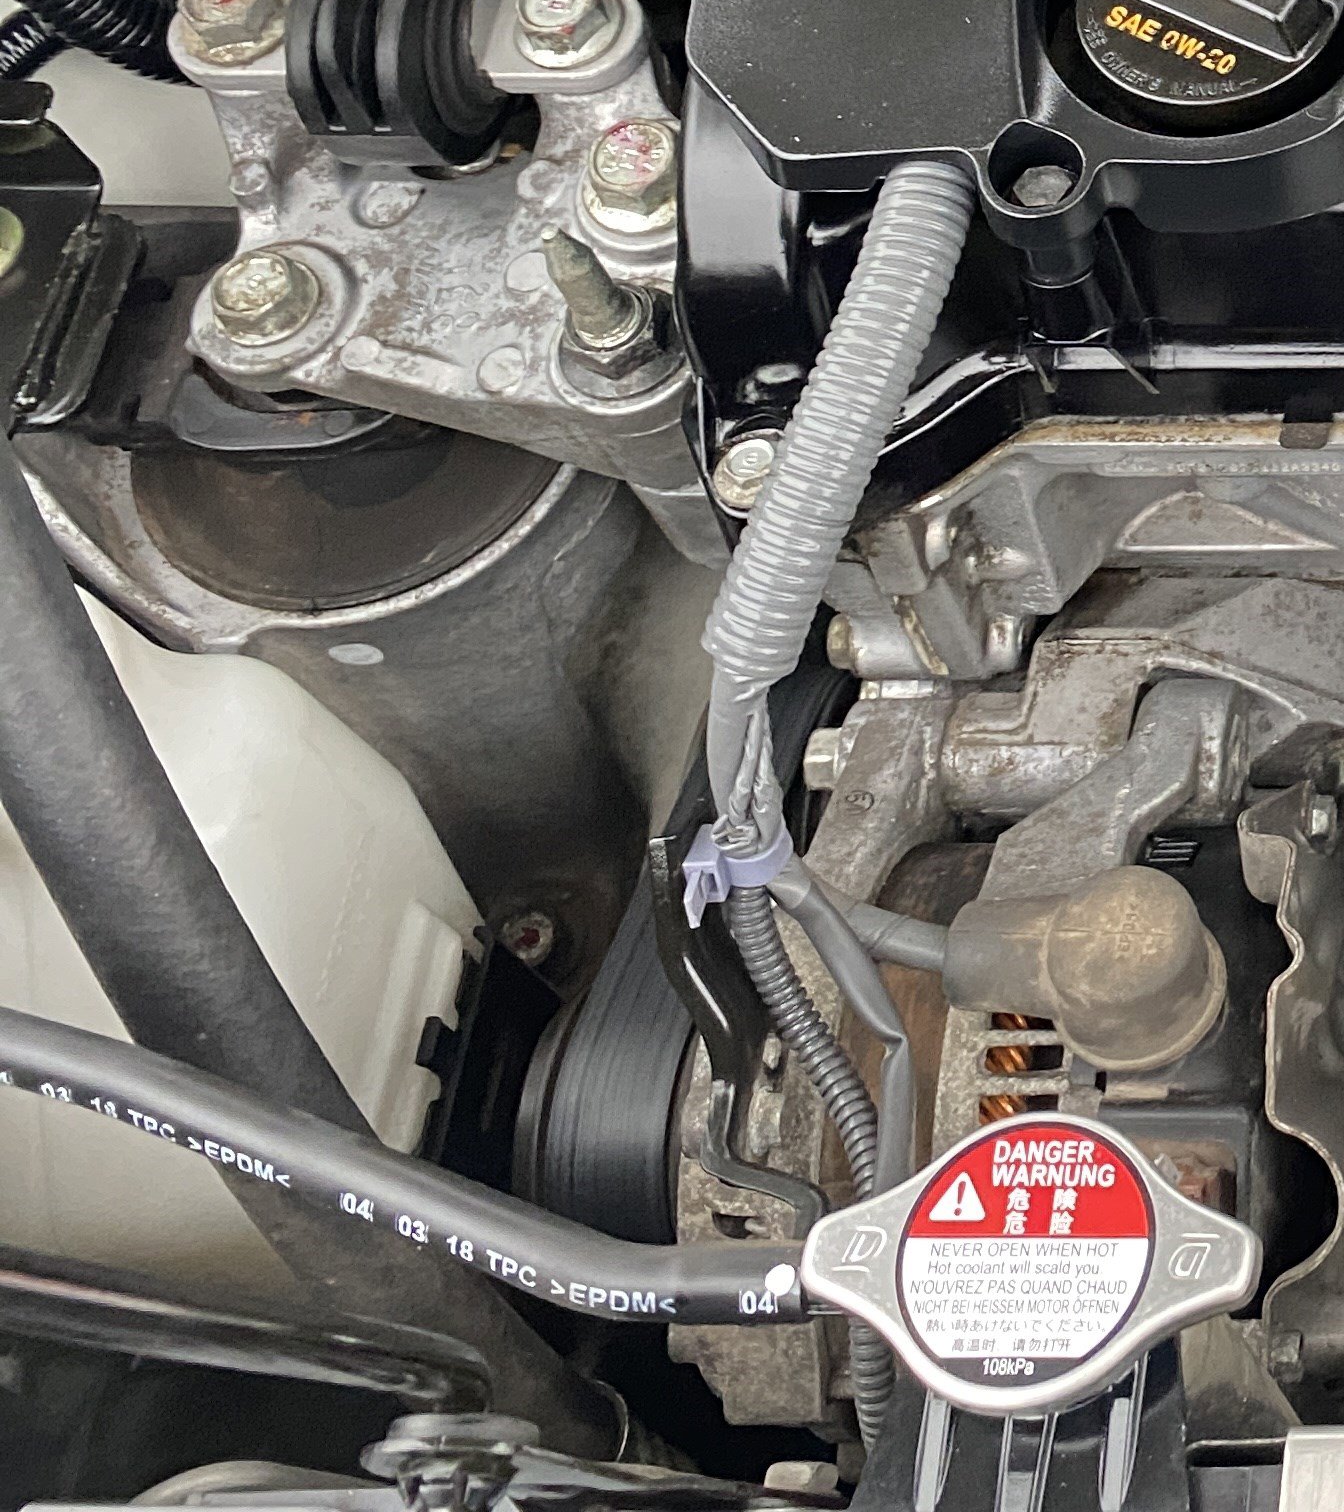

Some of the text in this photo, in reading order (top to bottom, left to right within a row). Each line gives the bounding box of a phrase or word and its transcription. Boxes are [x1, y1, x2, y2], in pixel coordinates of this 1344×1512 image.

[1104, 5, 1238, 76] SAE 0W-20
[993, 1140, 1095, 1164] DANGER
[992, 1164, 1116, 1188] WARNUNG
[126, 1107, 177, 1144] TPC
[444, 1233, 475, 1263] 18
[486, 1248, 538, 1289] TPC
[550, 1277, 679, 1316] >EPDM<
[930, 1242, 1119, 1258] NEVER OPEN WHEN HOT
[927, 1261, 951, 1275] Hot
[955, 1261, 1006, 1276] coolant
[1009, 1261, 1030, 1275] will
[1035, 1261, 1071, 1275] scald
[910, 1279, 1128, 1295] N'OUVREZ PAS QUAND CHAUD
[913, 1296, 1120, 1314] NICHT BEI HEISSEM MOTOR ÖFFNEN
[983, 1358, 1035, 1376] 108kPa
